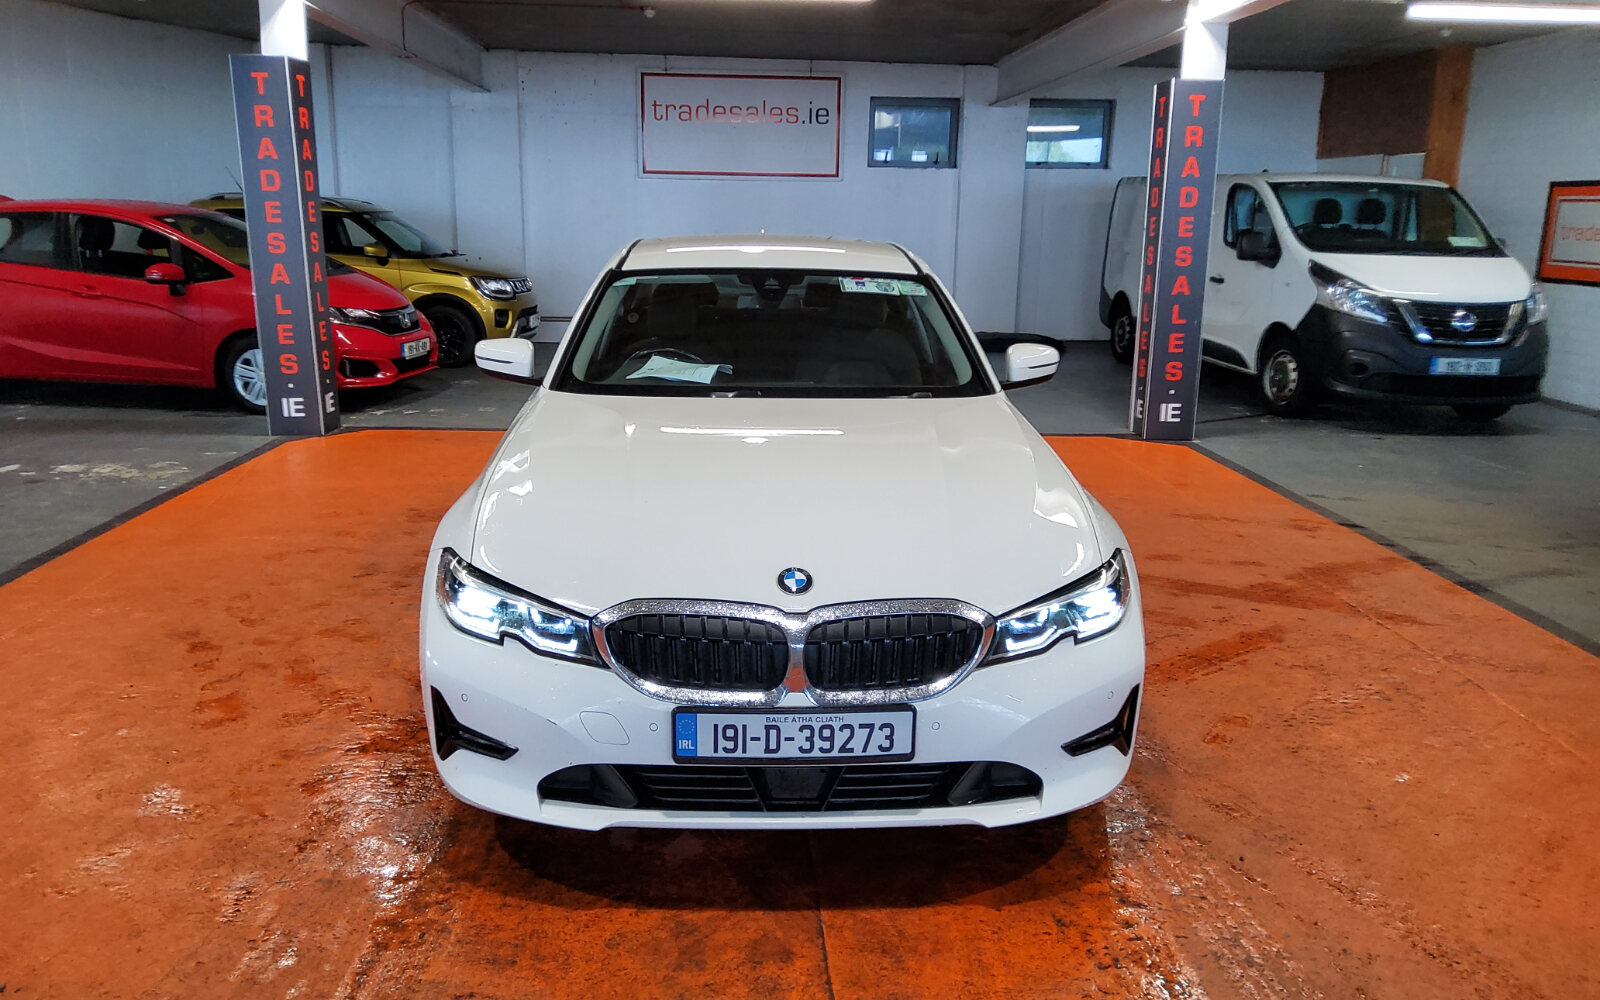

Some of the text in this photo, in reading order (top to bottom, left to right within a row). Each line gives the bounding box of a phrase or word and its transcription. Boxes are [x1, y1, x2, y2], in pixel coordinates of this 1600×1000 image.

[652, 98, 829, 124] tradesales.ie
[791, 714, 813, 723] ÁTHA
[815, 715, 844, 723] CLIATH
[678, 739, 695, 749] IRL
[713, 723, 895, 754] 191-D-39273
